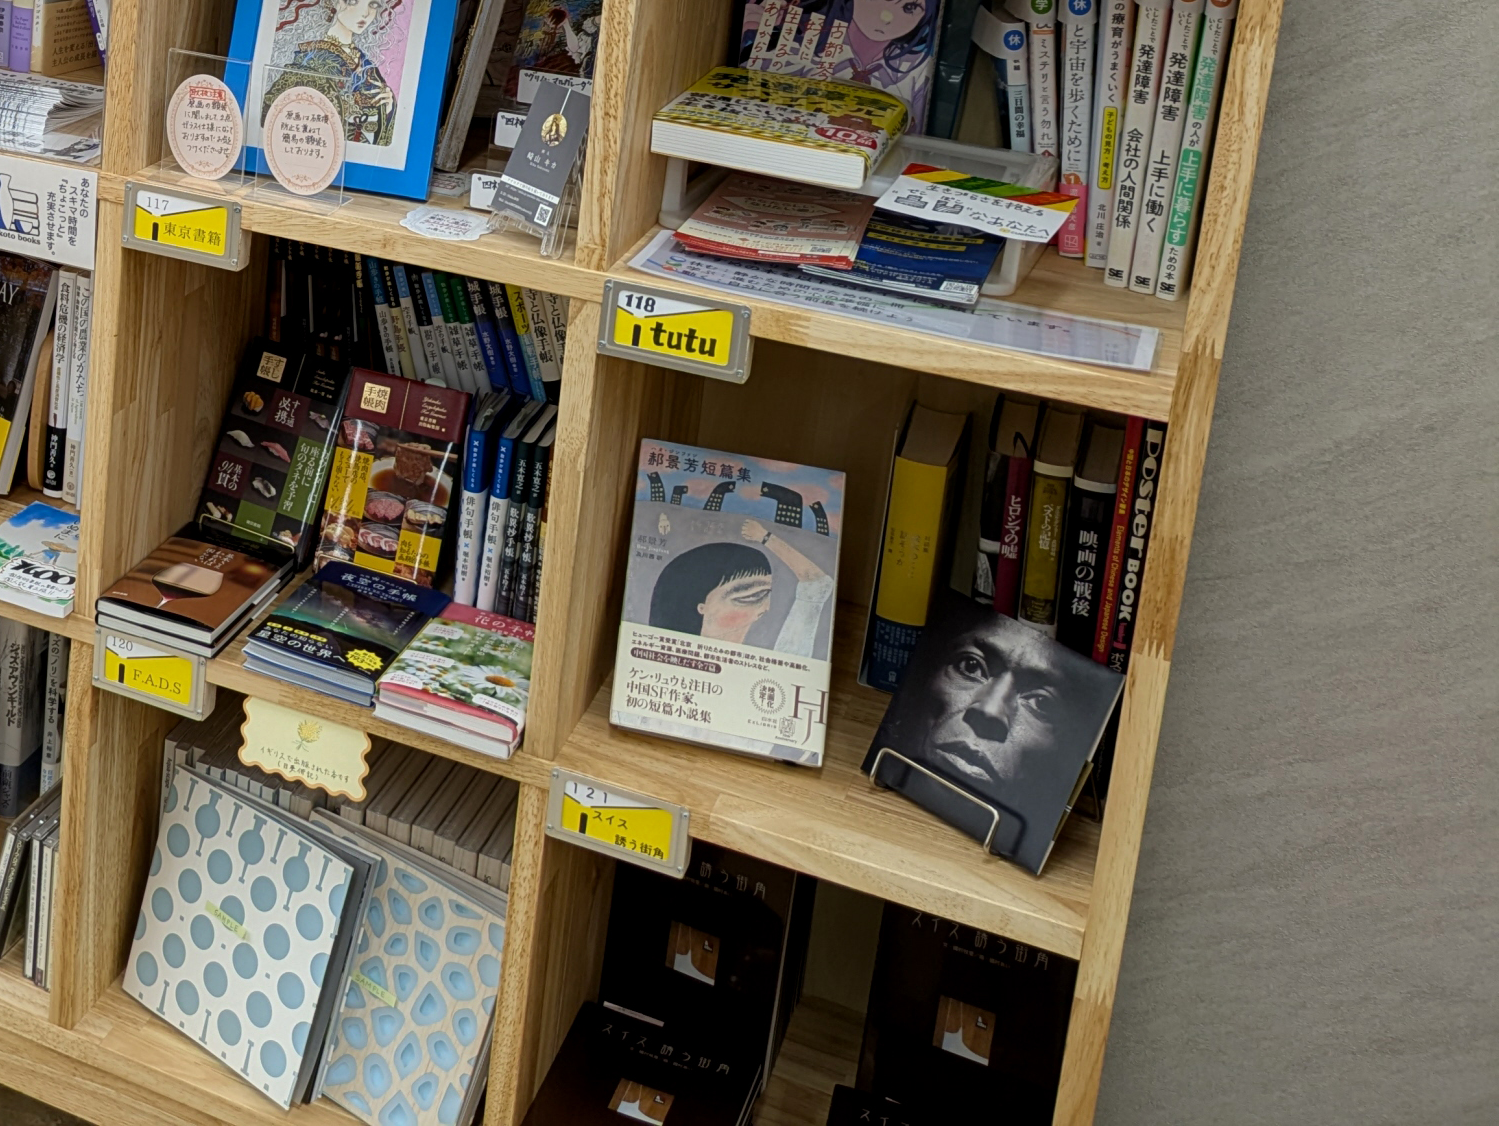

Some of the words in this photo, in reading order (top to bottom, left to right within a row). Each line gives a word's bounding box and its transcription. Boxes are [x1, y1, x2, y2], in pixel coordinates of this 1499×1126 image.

[1038, 37, 1053, 141] ミステリと言う勿れ
[1131, 44, 1157, 105] 発達障害
[1160, 51, 1189, 122] 発達障害
[1066, 24, 1088, 163] と宇宙を歩くために
[1013, 91, 1025, 139] 三日間の幸福
[1101, 110, 1115, 185] 子どもの見方・考え方
[1114, 127, 1144, 229] 会社の人間関係
[1145, 150, 1171, 234] 上手に働く
[56, 178, 69, 239] 『ちょこっと』
[79, 177, 90, 218] あなたの
[145, 196, 171, 212] 117
[1169, 150, 1200, 243] 上手に暮らす
[45, 191, 56, 257] 充実させます。
[68, 185, 79, 247] スキマ時間を
[162, 221, 222, 247] 東京書籍
[18, 232, 41, 246] books
[1108, 267, 1124, 278] SE
[1164, 247, 1179, 280] ための本
[467, 280, 486, 315] 城手帳
[623, 293, 657, 314] 118
[54, 282, 71, 363] 食料危機の経済学
[526, 288, 554, 364] 寺と仏像手帳
[650, 321, 718, 359] tutu
[465, 326, 485, 372] 雑草手帳
[362, 385, 375, 410] 手帳
[375, 387, 389, 411] 焼肉
[283, 443, 310, 511] 旬のタネを予習
[648, 451, 752, 483] 郝景芳短篇集
[463, 495, 476, 540] 俳句手帳
[487, 500, 501, 545] 俳句手帳
[1000, 495, 1022, 559] ヒロシマの嘘
[1112, 525, 1125, 555] Elements
[340, 572, 418, 604] 夜空の手帳
[1071, 529, 1099, 617] 映画の戦後
[1107, 562, 1119, 588] Chinese
[1118, 558, 1140, 622] BOOK
[1101, 601, 1113, 631] Japanese
[112, 637, 134, 653] 120
[255, 629, 346, 664] 星空の世界へ
[1098, 631, 1108, 653] Design
[132, 667, 182, 695] F.A.D.S
[626, 682, 699, 708] 中国SF作家、
[628, 668, 723, 696] ケン・リュウも注目の
[625, 696, 712, 725] 初の短篇小説集
[571, 781, 608, 804] 121
[591, 808, 628, 831] スイス
[614, 832, 665, 861] 誘う街角
[700, 861, 766, 900] 誘う街角
[212, 909, 240, 934] SAMPLE
[911, 909, 961, 941] スイス
[975, 930, 1051, 972] 誘う街角
[354, 974, 387, 998] SAMPLE
[602, 1024, 648, 1049] スイス
[660, 1042, 730, 1076] 誘う街角
